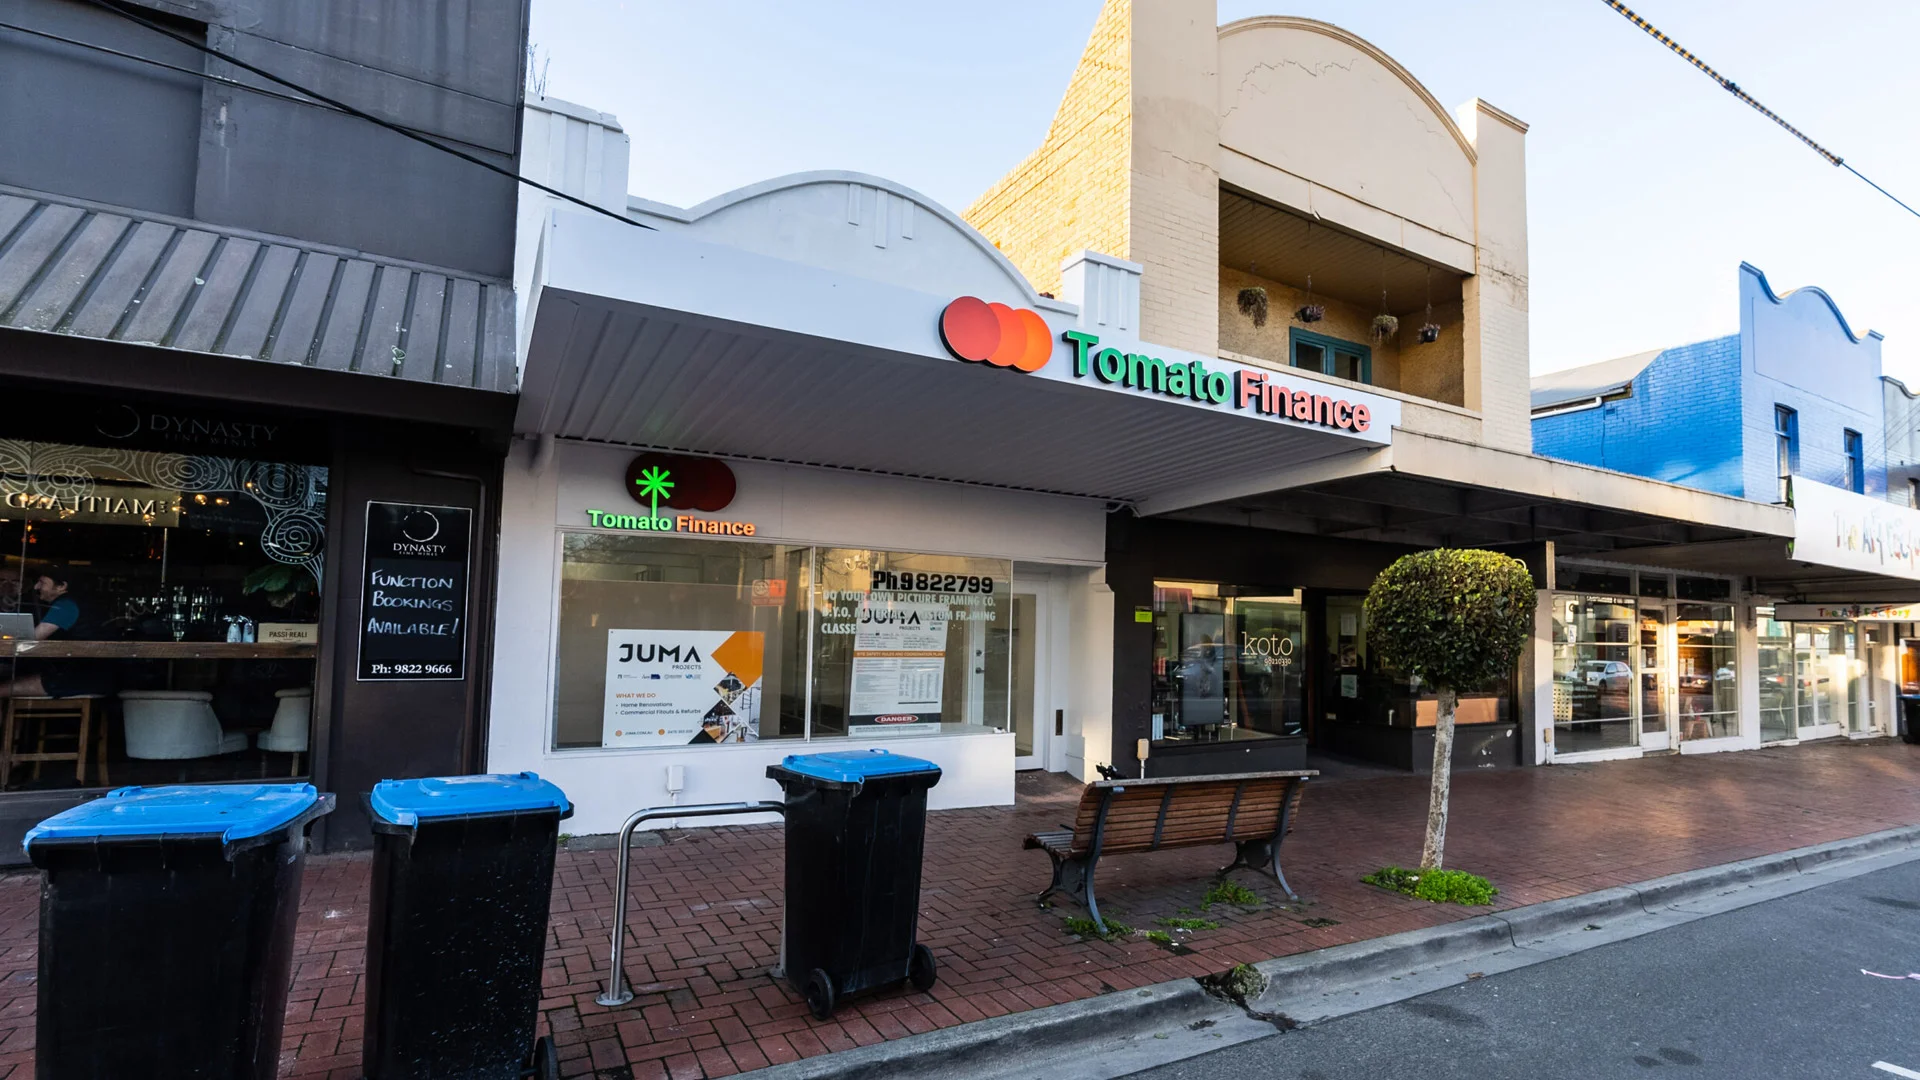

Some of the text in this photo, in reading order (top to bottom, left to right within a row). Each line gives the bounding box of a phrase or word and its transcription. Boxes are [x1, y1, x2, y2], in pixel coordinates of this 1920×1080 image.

[1063, 329, 1371, 432] Tomato Finance
[150, 413, 279, 441] DYNASTY
[586, 509, 756, 536] Tomato Finance
[393, 542, 446, 554] DYNASTY
[371, 569, 453, 589] FUNCTION
[372, 590, 453, 612] BOOKINGS
[870, 592, 895, 602] OWN
[897, 592, 936, 603] PICTURE
[938, 594, 980, 606] FRAMING
[1818, 607, 1838, 617] The
[367, 617, 459, 638] AVAILABLE!
[619, 643, 702, 663] JUMA
[1241, 631, 1293, 656] koto
[371, 664, 452, 674] Ph: 9822 9666
